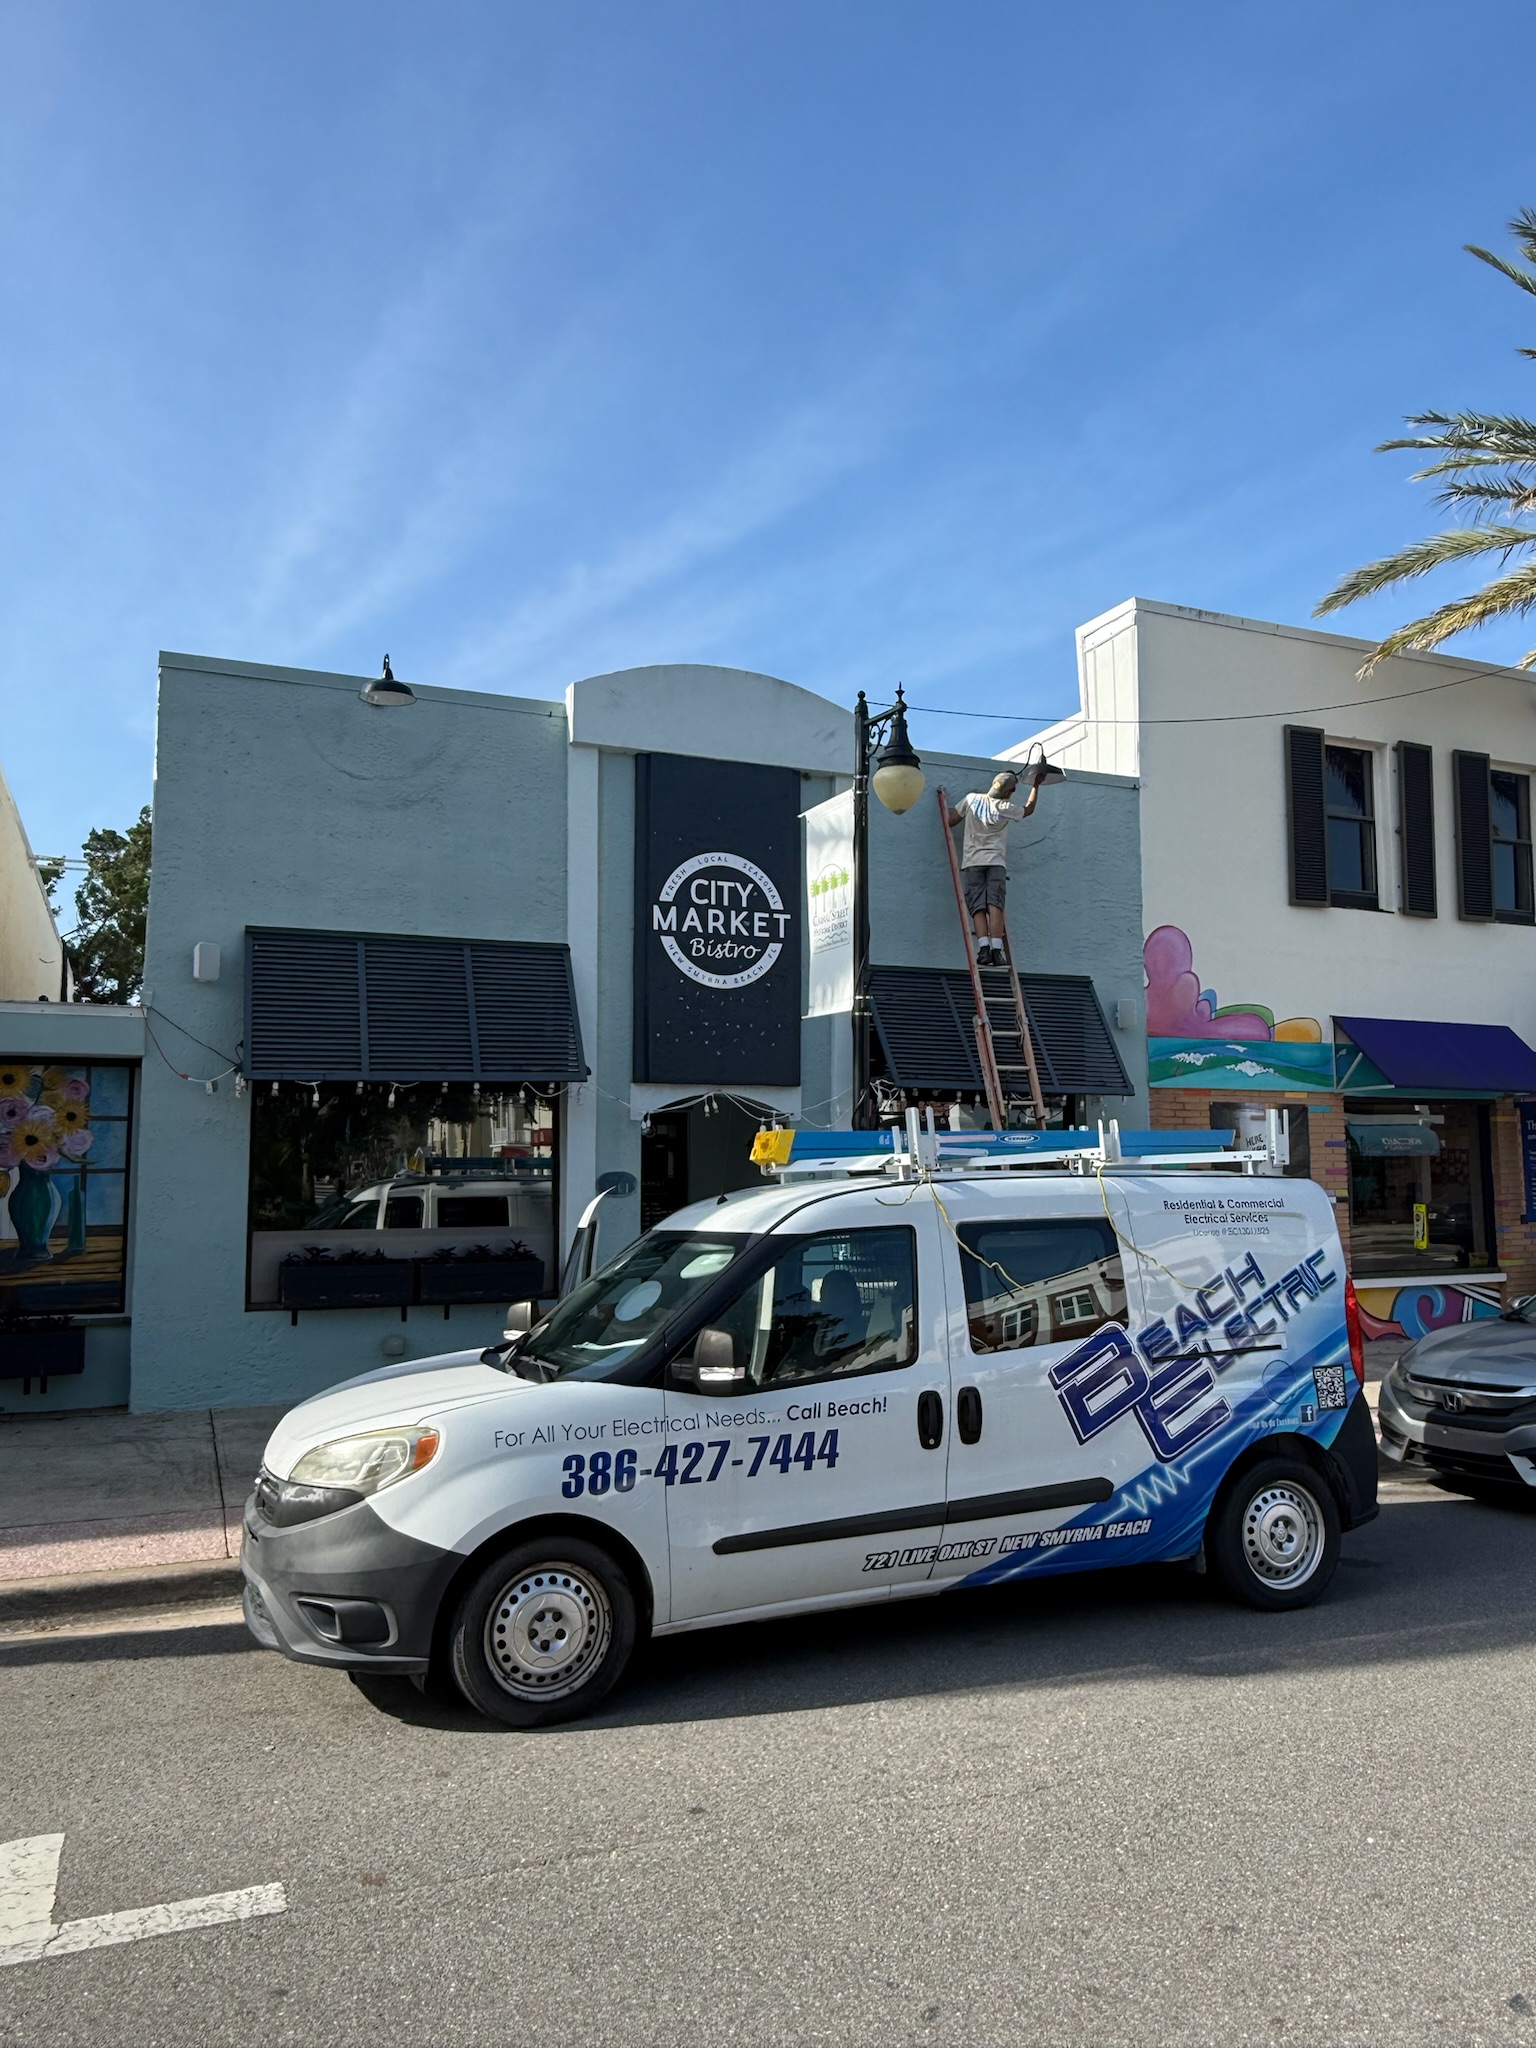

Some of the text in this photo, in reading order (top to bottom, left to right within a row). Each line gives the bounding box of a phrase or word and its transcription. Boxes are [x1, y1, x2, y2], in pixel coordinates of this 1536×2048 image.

[665, 856, 779, 906] FRESH LOCAL SEASONAL
[690, 878, 754, 908] CITY
[652, 904, 791, 939] MARKET
[668, 943, 685, 964] NEW
[733, 965, 764, 984] BEACH
[689, 937, 761, 959] Bistro
[1163, 1198, 1285, 1210] Residential & Commercial
[1184, 1213, 1269, 1224] Electrical Services
[494, 1396, 888, 1449] For All Your Electrical Needs... Call Beach!
[561, 1428, 840, 1499] 386-427-7444
[862, 1518, 1152, 1572] 721 LIVE OAK ST NEW SMYRNA BEACH
